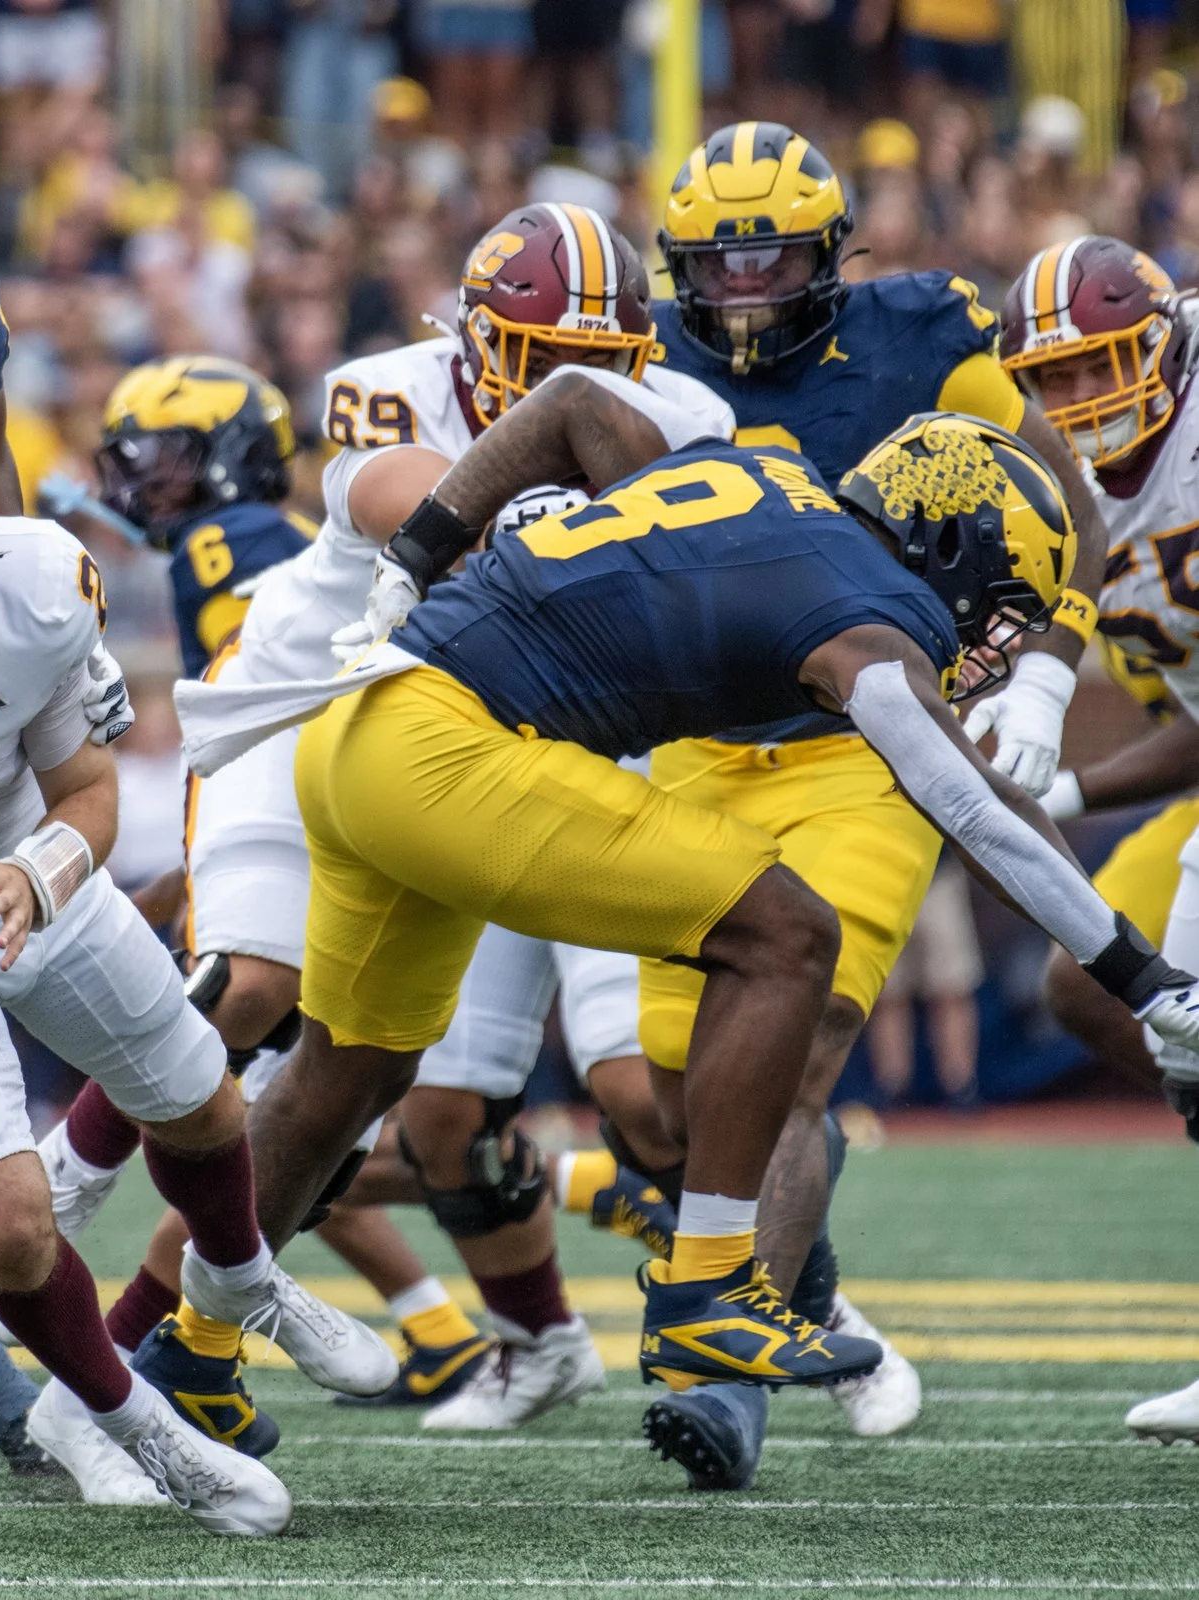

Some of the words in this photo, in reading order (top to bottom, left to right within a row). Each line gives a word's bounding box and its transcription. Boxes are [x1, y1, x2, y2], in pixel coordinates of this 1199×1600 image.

[736, 217, 756, 236] M
[577, 318, 610, 332] 1974
[329, 379, 418, 449] 69
[516, 459, 765, 560] 8
[186, 524, 234, 588] 6
[1062, 599, 1087, 619] M
[643, 1332, 661, 1354] M
